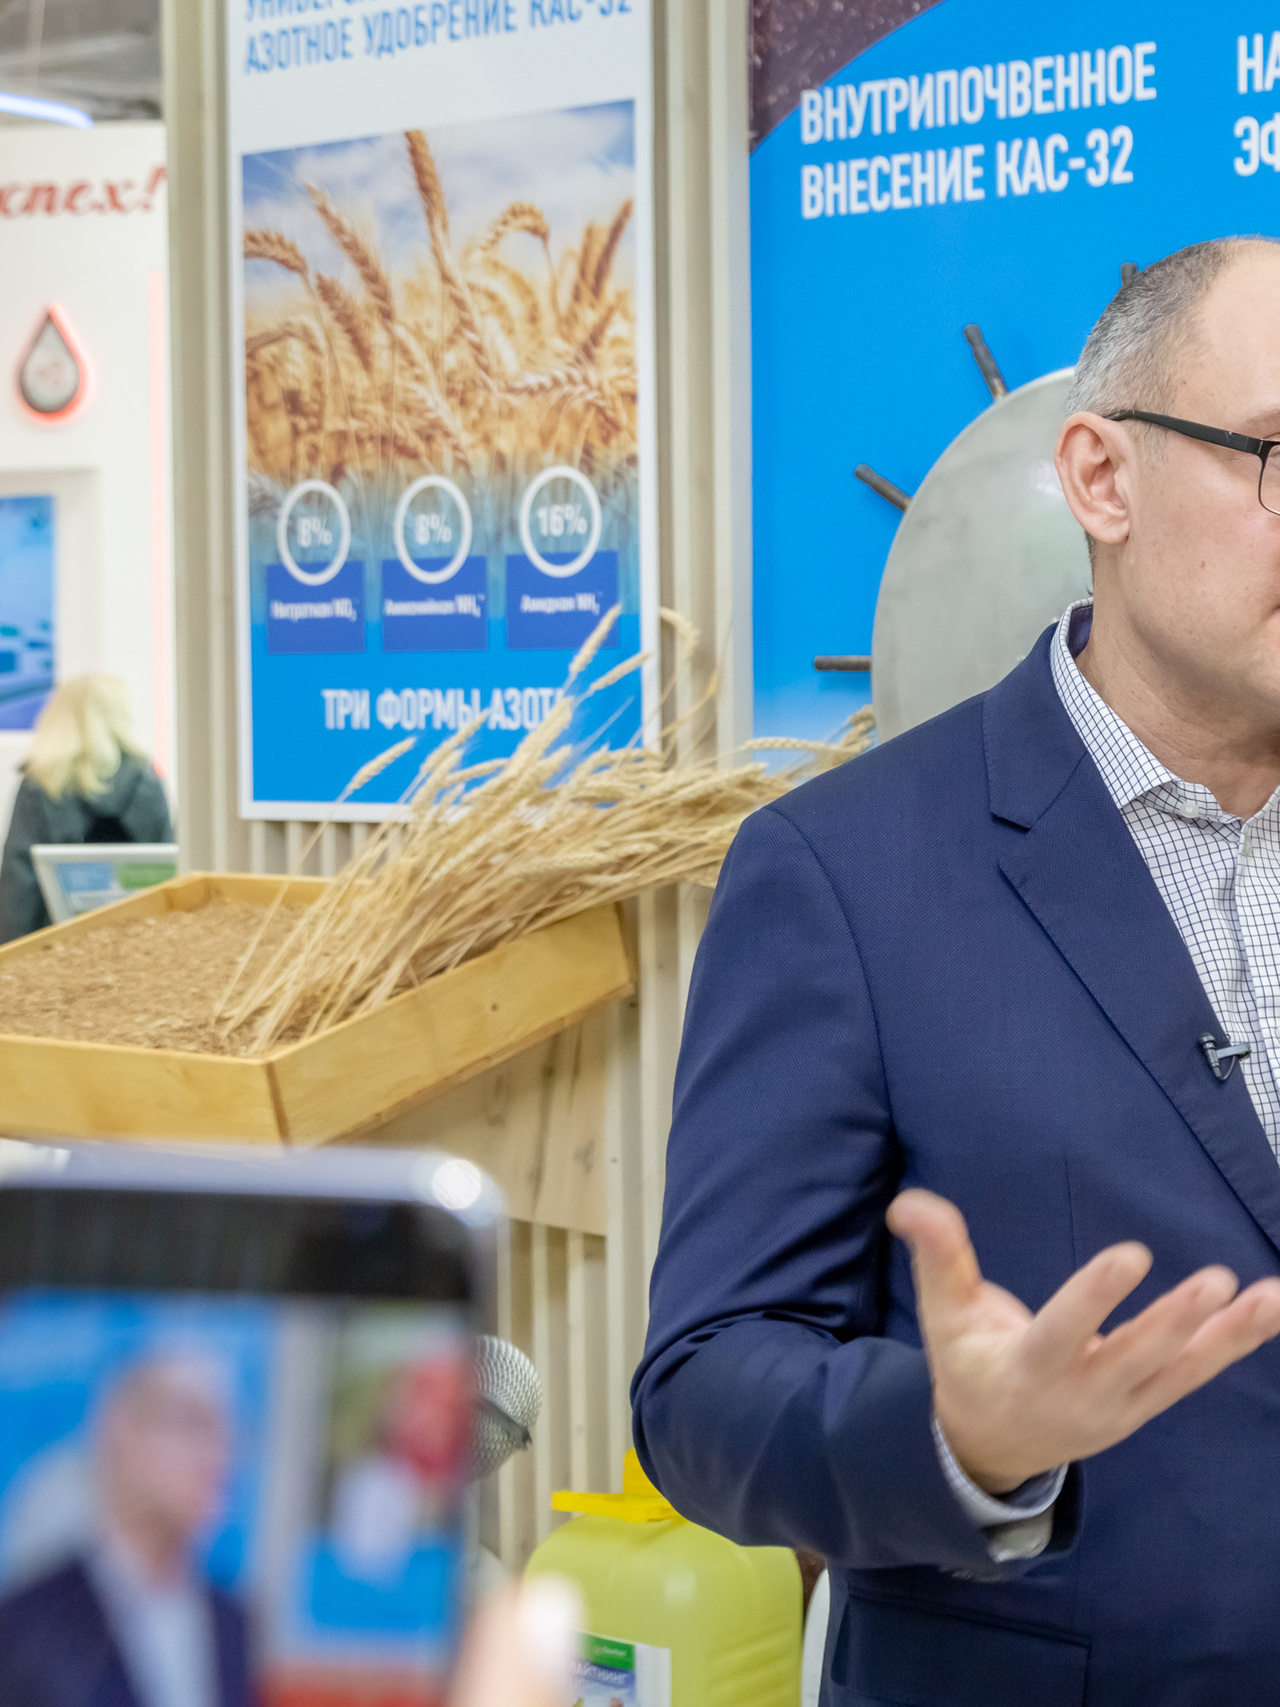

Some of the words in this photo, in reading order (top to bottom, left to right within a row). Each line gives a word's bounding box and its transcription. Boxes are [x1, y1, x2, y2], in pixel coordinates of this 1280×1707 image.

[245, 17, 352, 74] АЗОТНОЕ
[363, 0, 517, 58] УДОБРЕНИЕ
[801, 42, 1157, 144] ВНУТРИПОЧВЕННОЕ
[801, 145, 984, 219] ВНЕСЕНИЕ
[998, 125, 1134, 197] КАС-32
[537, 503, 588, 537] 16%
[321, 688, 370, 730] ТРИ
[376, 688, 481, 730] ФОРМЫ
